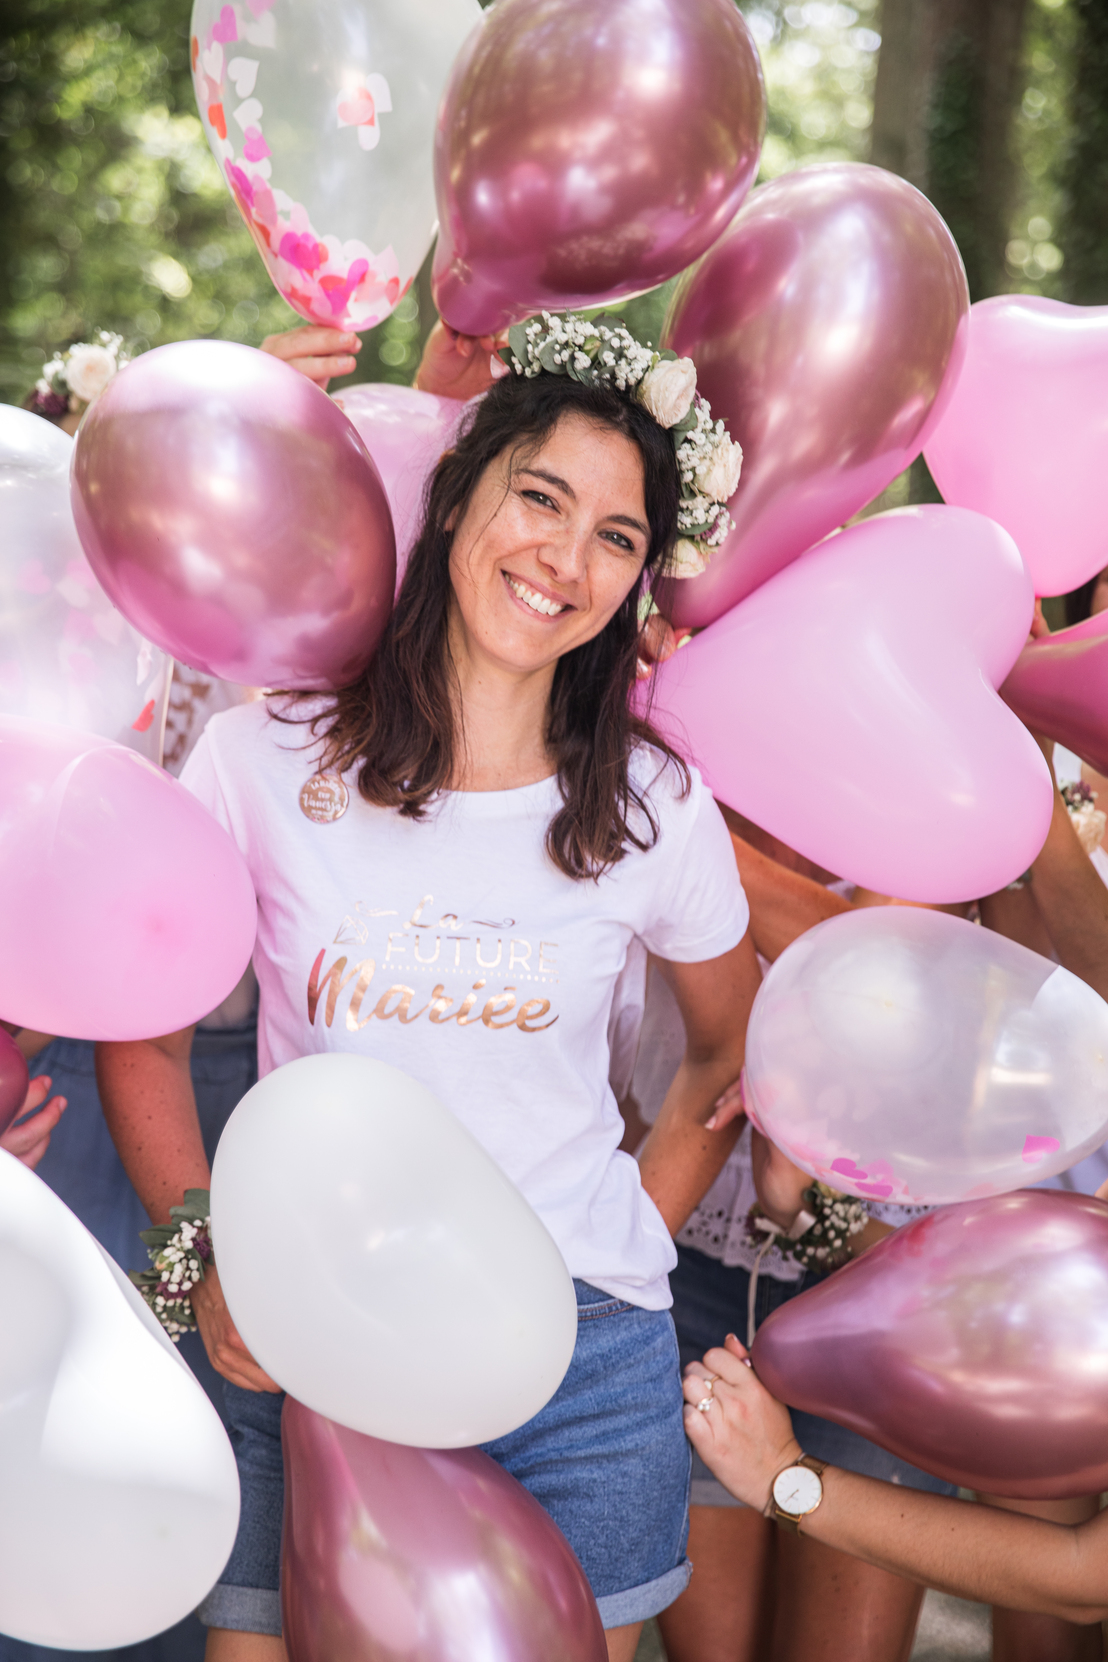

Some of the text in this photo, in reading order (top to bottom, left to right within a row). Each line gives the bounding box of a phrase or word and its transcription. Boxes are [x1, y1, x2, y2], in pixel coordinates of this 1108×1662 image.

[302, 793, 342, 812] Vanessa
[402, 894, 464, 930] La
[385, 932, 560, 974] FUTURE
[307, 948, 560, 1033] Mariée
